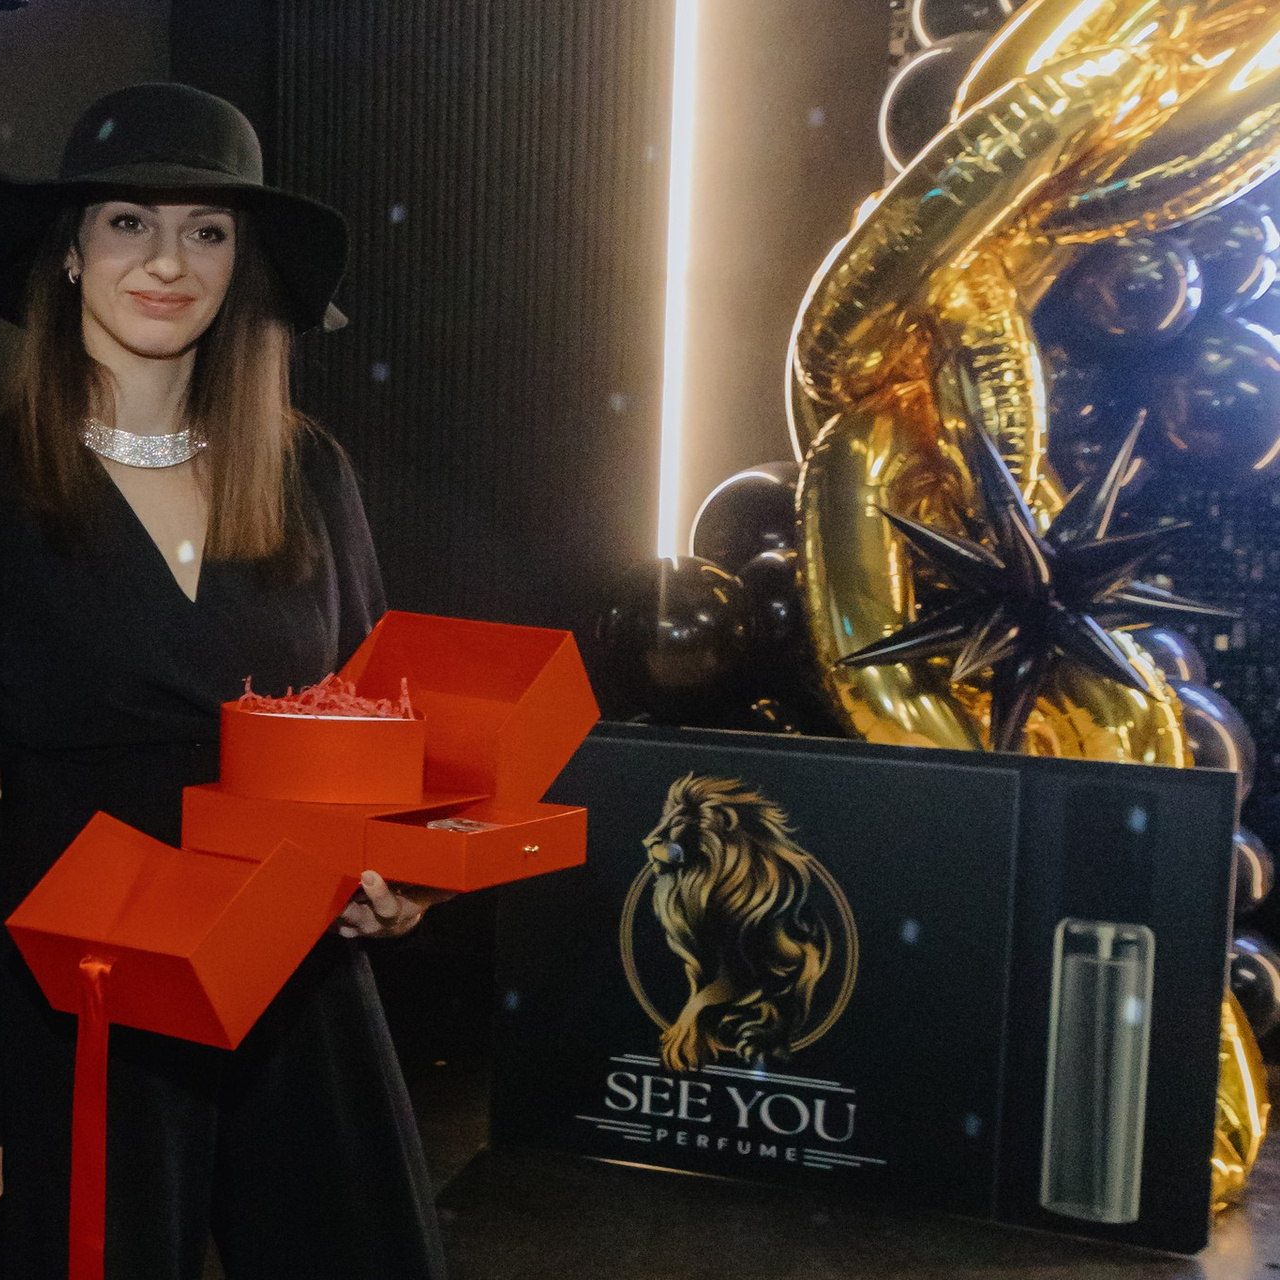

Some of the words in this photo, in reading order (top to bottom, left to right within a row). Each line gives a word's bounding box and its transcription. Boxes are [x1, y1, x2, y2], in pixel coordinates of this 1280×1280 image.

[604, 1071, 712, 1123] SEE
[725, 1086, 857, 1143] YOU
[656, 1128, 798, 1162] PERFUME
